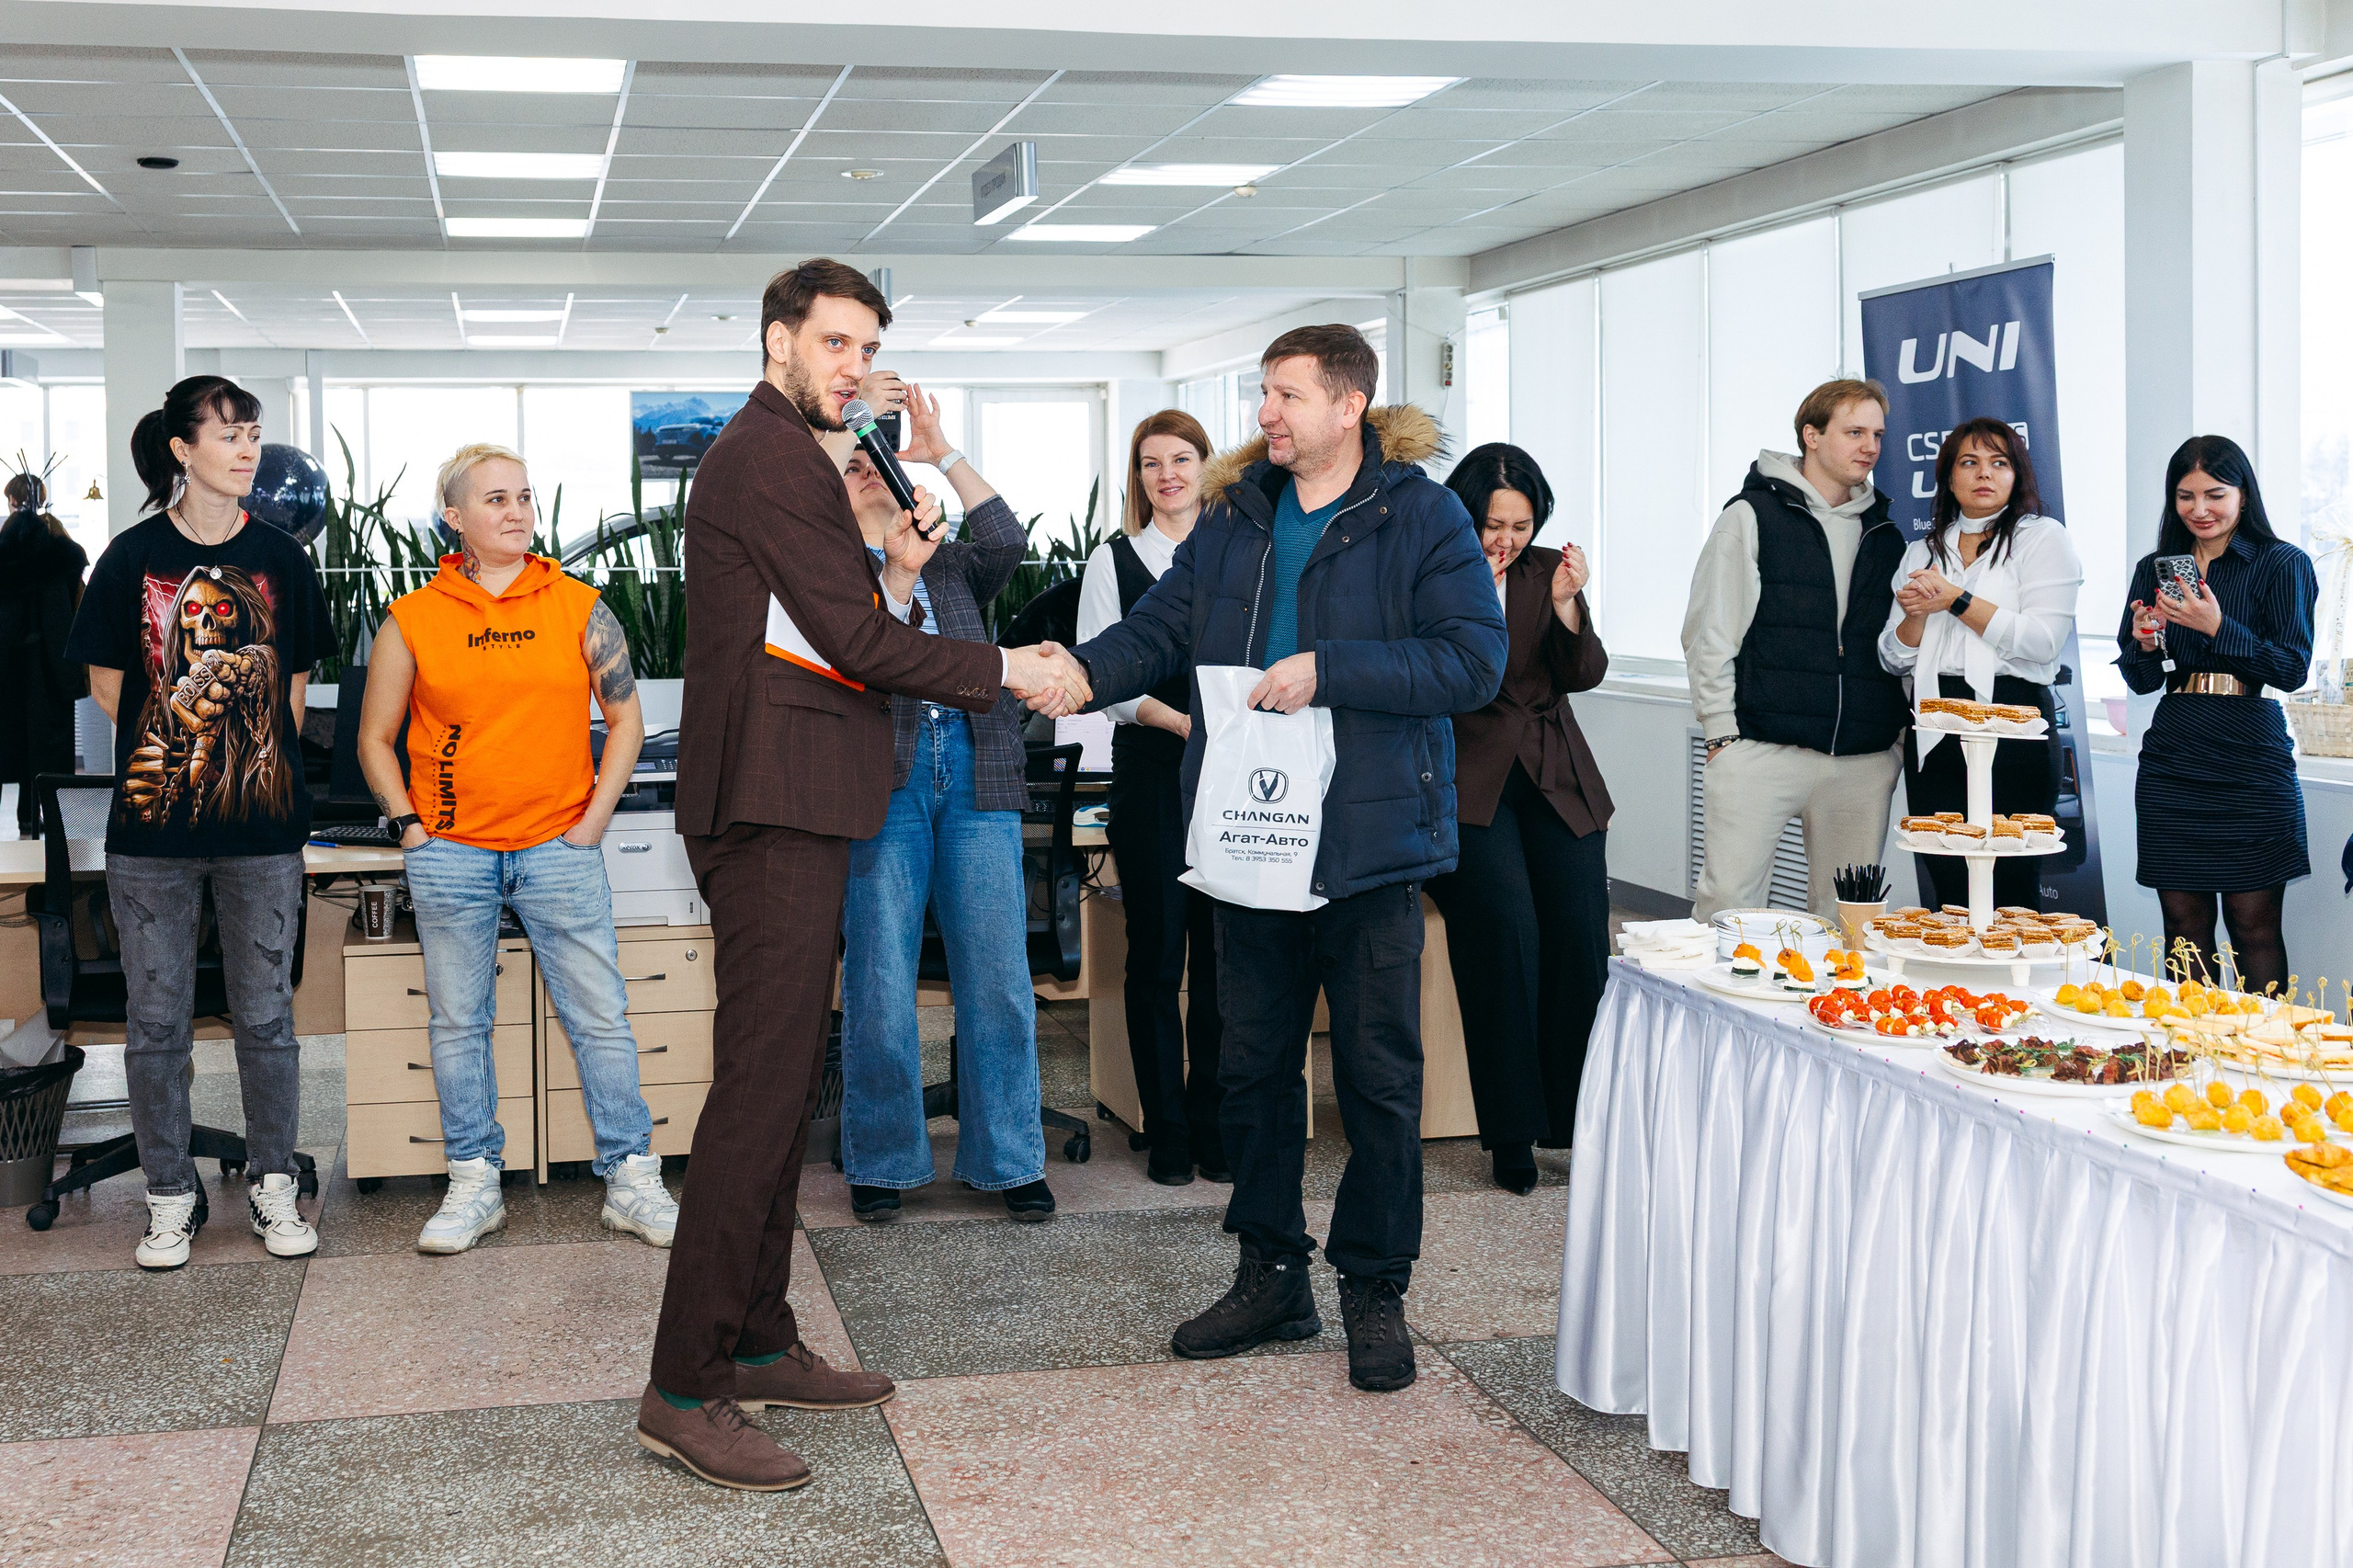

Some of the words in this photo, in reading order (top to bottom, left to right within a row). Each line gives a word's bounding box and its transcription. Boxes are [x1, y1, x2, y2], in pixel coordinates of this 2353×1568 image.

[1898, 321, 2020, 384] UNI
[468, 627, 536, 648] Inferno
[483, 643, 521, 652] STYLE
[177, 668, 211, 703] BOSS
[1222, 810, 1310, 824] CHANGAN
[1219, 831, 1309, 847] Агат-Авто
[1247, 849, 1291, 858] Коммунальная,
[370, 901, 379, 928] COFFEE
